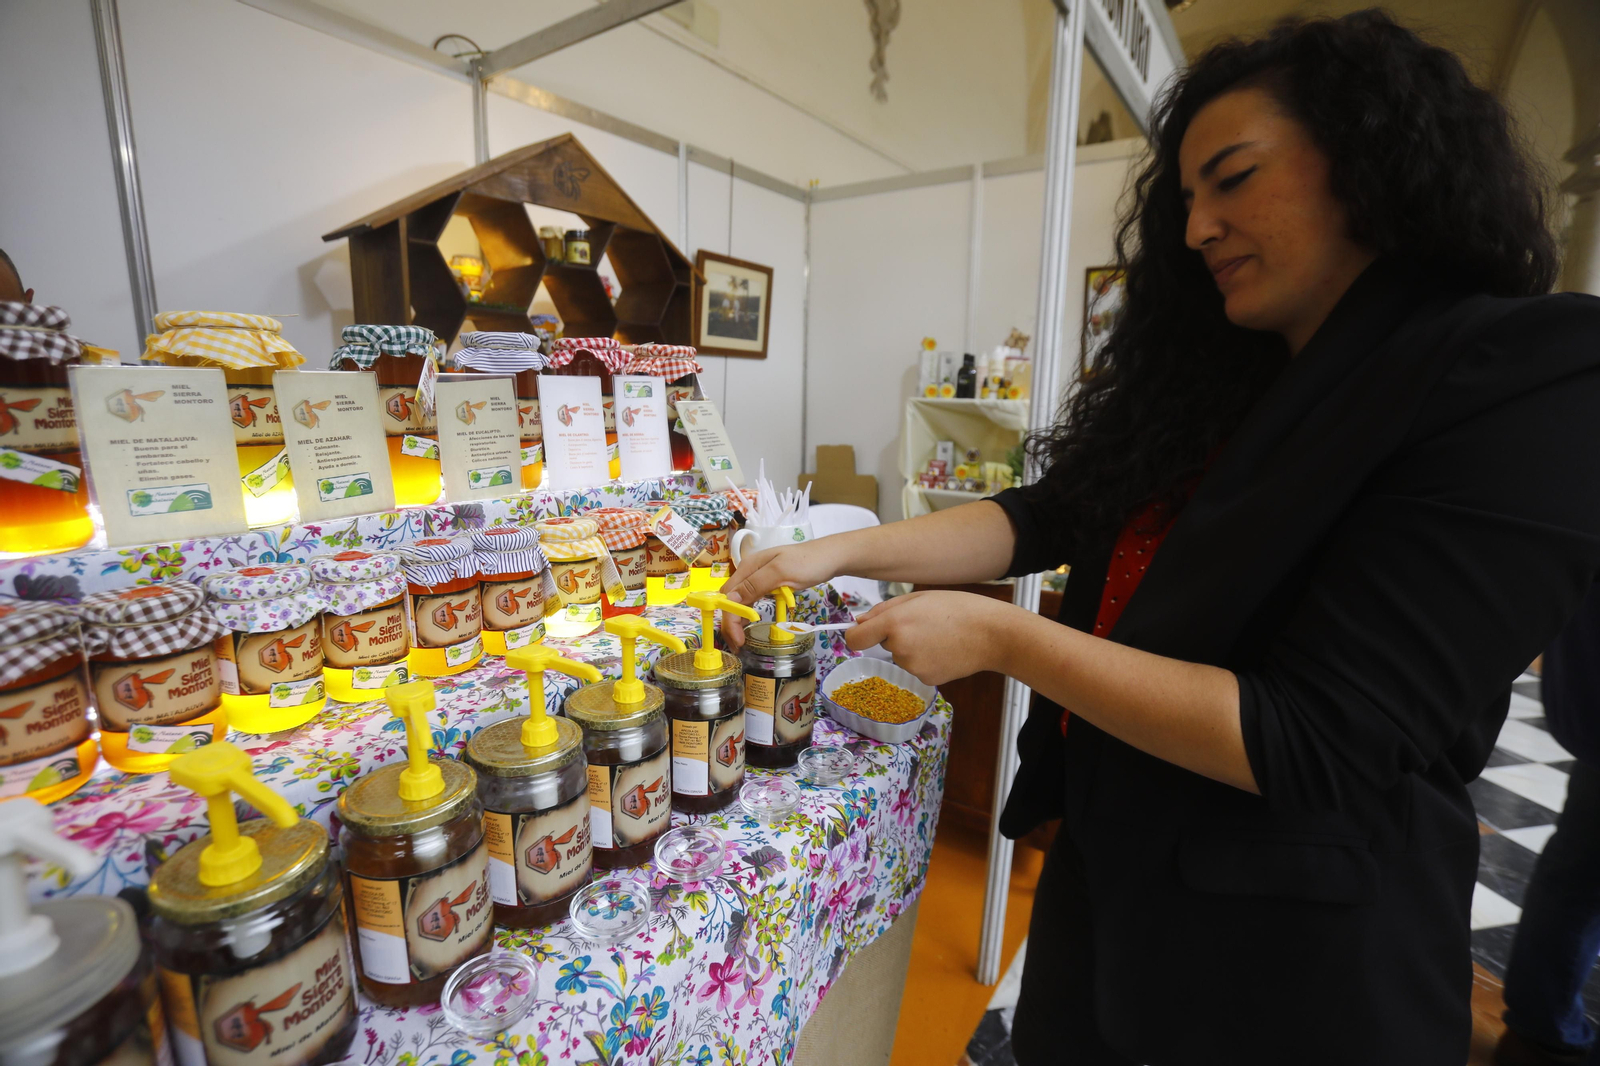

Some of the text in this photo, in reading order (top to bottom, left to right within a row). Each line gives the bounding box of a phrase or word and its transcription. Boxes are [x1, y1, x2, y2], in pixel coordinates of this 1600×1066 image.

[57, 397, 74, 408] Mie
[48, 407, 75, 420] Sierr
[34, 419, 77, 430] Montor
[134, 444, 159, 452] Buena
[666, 534, 678, 544] MIEL
[670, 532, 686, 547] SIERRA
[674, 531, 694, 552] MONTORO
[387, 612, 402, 626] Miel
[379, 623, 402, 636] Sierra
[369, 631, 403, 647] Montoro
[191, 655, 211, 673] Miel
[181, 668, 213, 686] Sierra
[54, 684, 78, 703] Miel
[168, 677, 214, 700] Montoro
[42, 697, 80, 719] Sierra
[26, 707, 81, 736] Montoro
[648, 815, 660, 825] Miel
[559, 868, 574, 880] Miel
[458, 930, 474, 945] Miel
[315, 948, 341, 983] Miel
[302, 964, 343, 1006] Sierra
[284, 977, 345, 1031] Montoro
[270, 1041, 296, 1058] Miel
